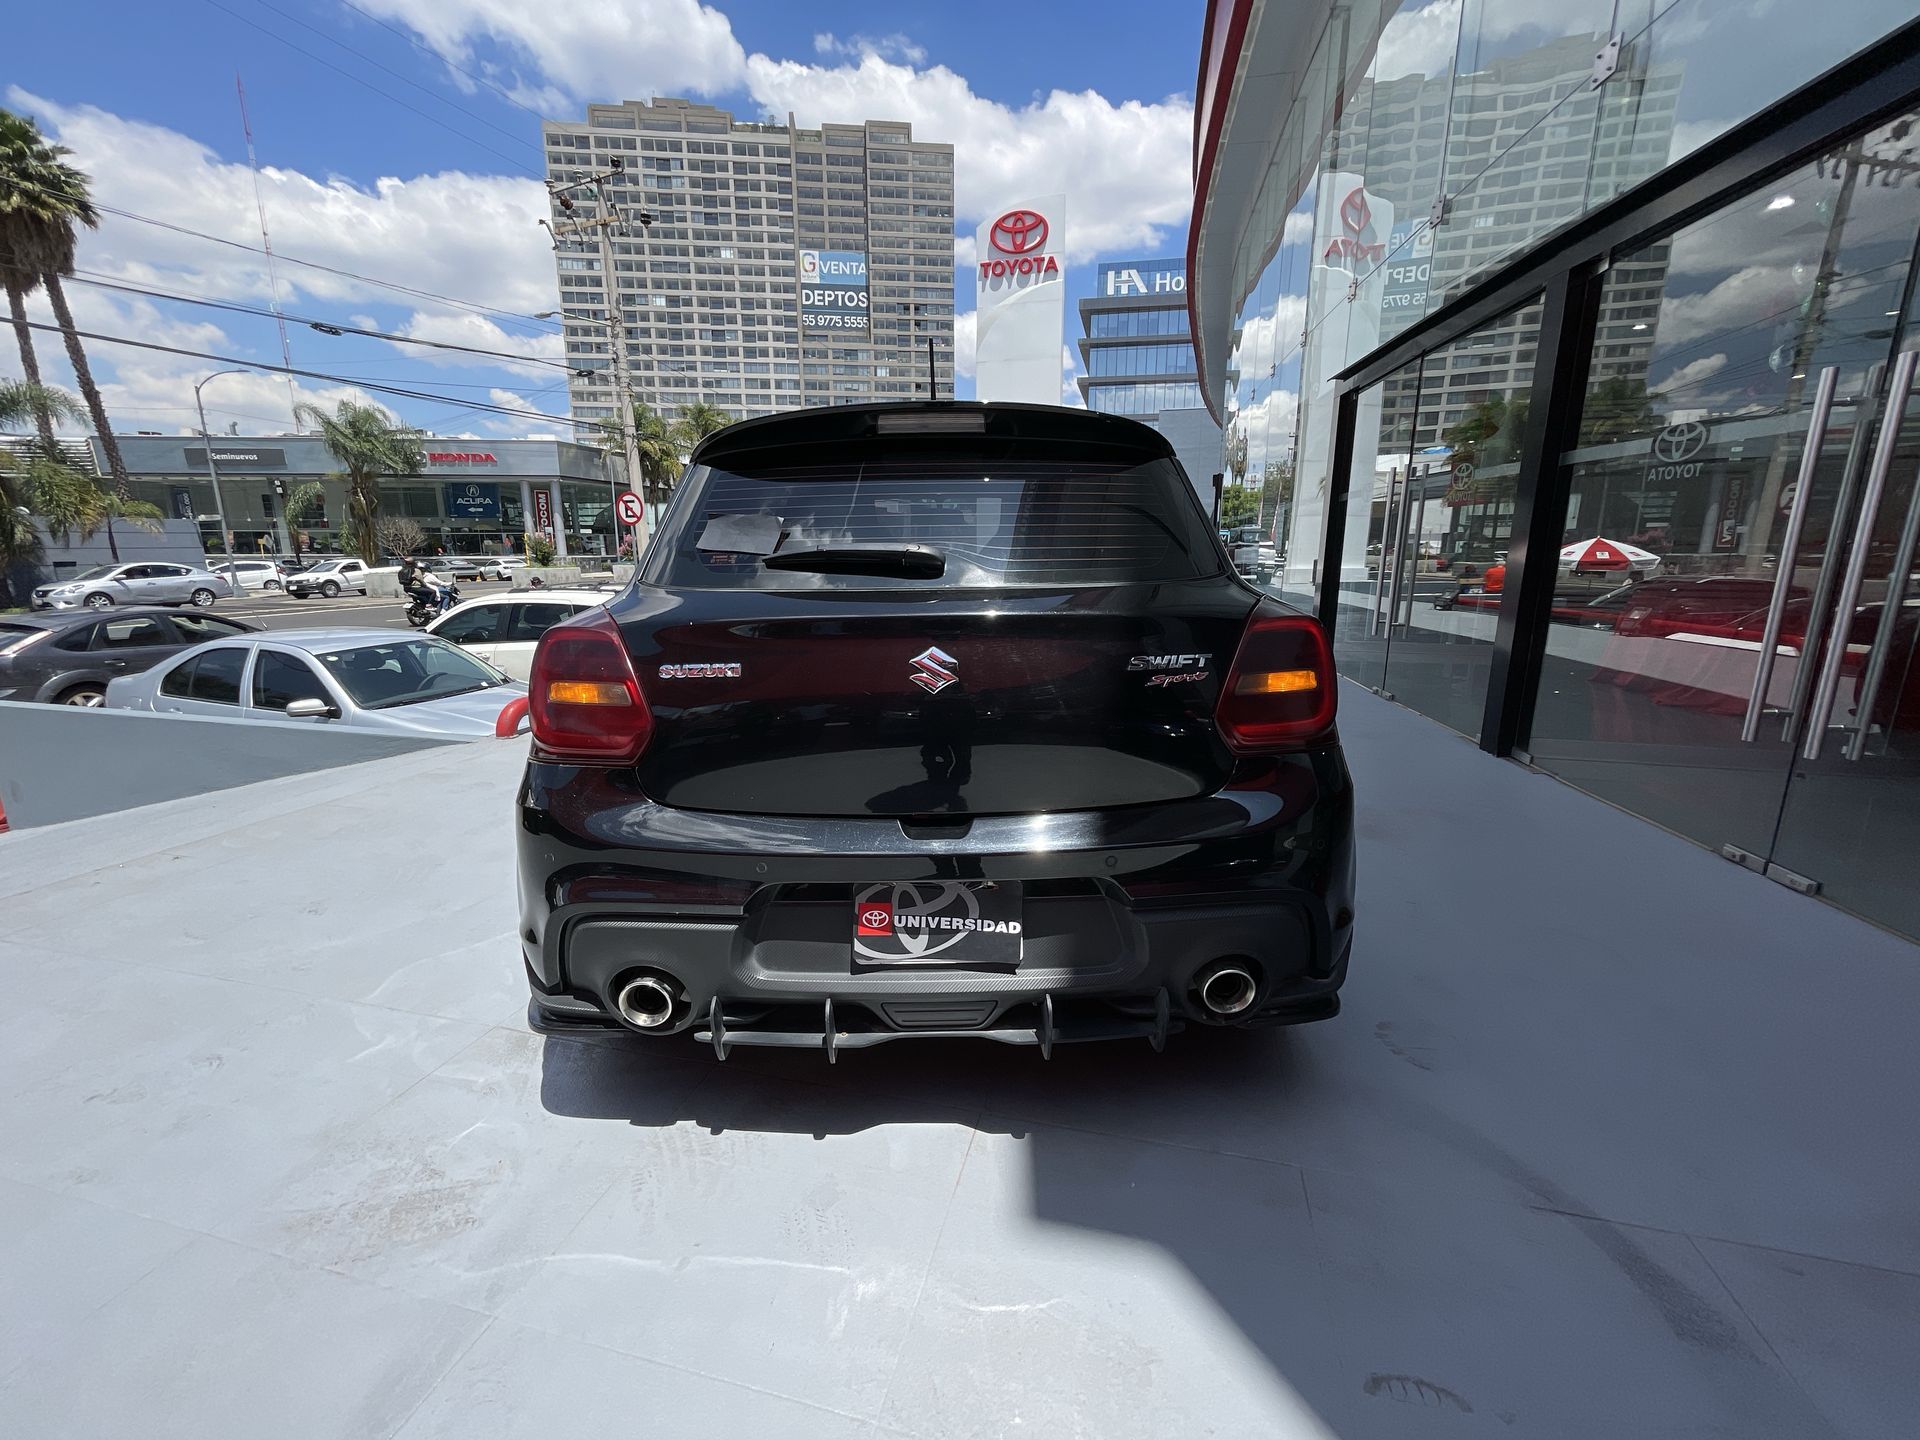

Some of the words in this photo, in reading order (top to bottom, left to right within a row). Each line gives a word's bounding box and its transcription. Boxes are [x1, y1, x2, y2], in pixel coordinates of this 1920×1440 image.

[820, 260, 867, 275] VENTA
[980, 256, 1059, 279] TOYOTA
[1156, 272, 1187, 292] Ho
[802, 289, 868, 308] DEPTOS
[803, 315, 815, 326] 55
[817, 315, 842, 327] 9775
[844, 317, 869, 328] 5555
[211, 453, 258, 461] Seminuevos
[429, 452, 497, 463] HONDA
[456, 497, 493, 505] ACURA
[658, 662, 741, 679] SUZUKI
[1127, 653, 1213, 671] SWIFT
[1144, 671, 1209, 688] Sport
[893, 915, 1022, 934] UNIVERSIDAD
